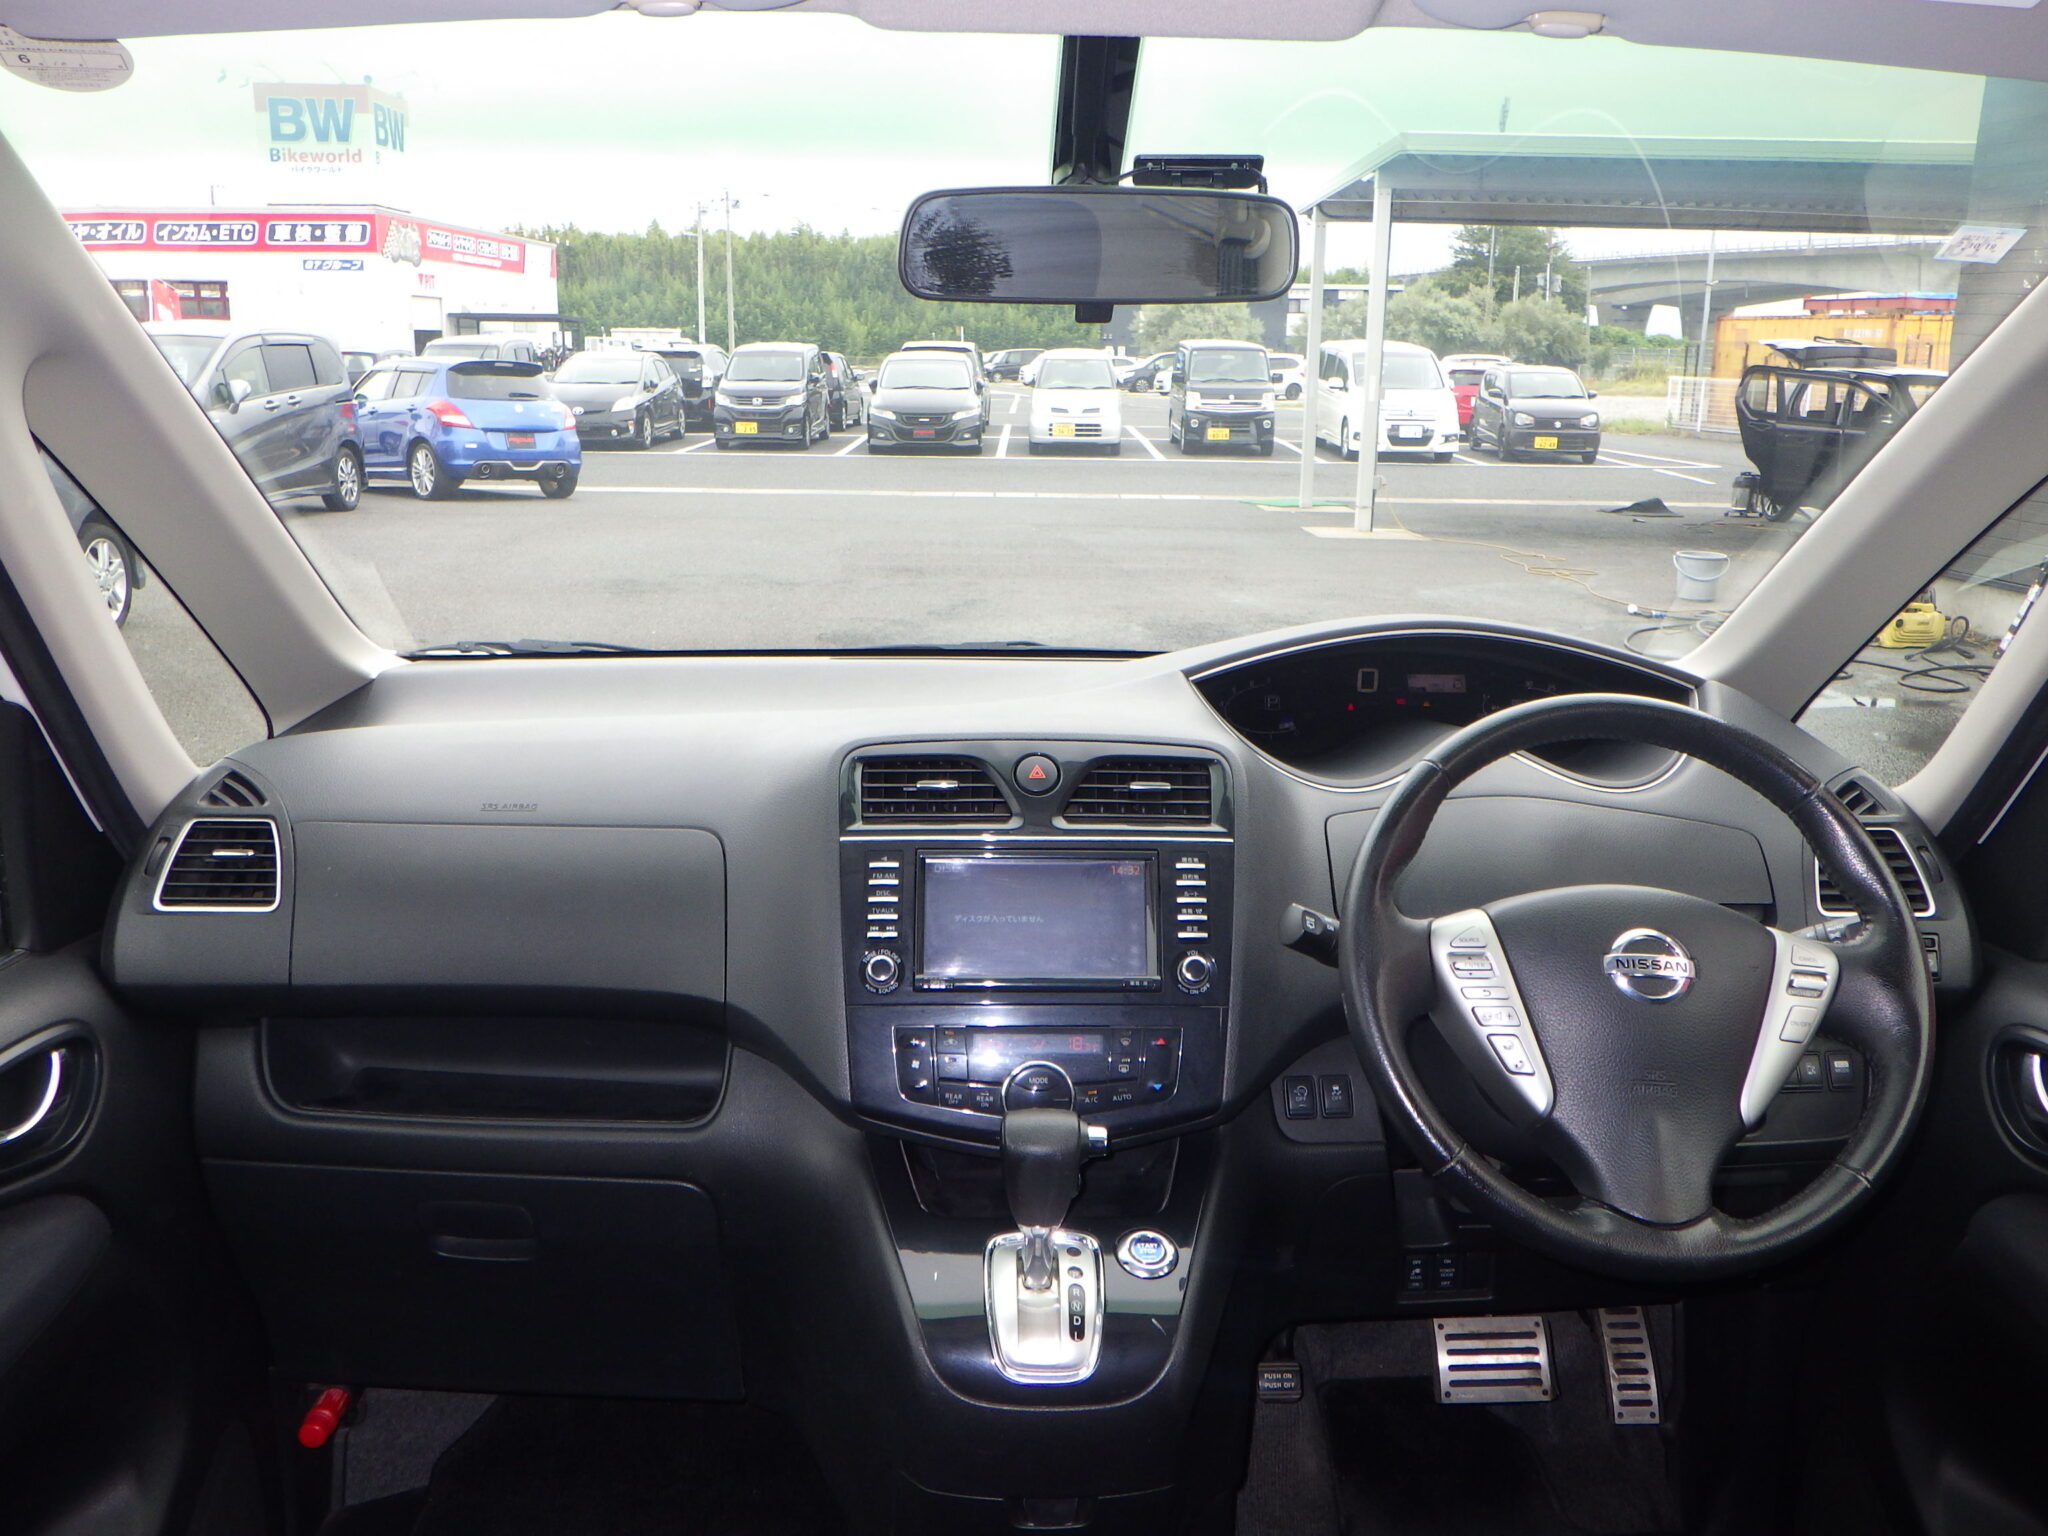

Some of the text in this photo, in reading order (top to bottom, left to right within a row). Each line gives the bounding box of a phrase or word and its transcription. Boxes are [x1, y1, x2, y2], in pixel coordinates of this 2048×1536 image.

[267, 97, 355, 142] BW
[373, 102, 404, 152] BW
[270, 147, 363, 163] Bikeworld
[1615, 958, 1688, 973] NISSAN
[1113, 1094, 1132, 1102] AUTO
[1072, 1288, 1080, 1297] R
[1073, 1315, 1081, 1326] D
